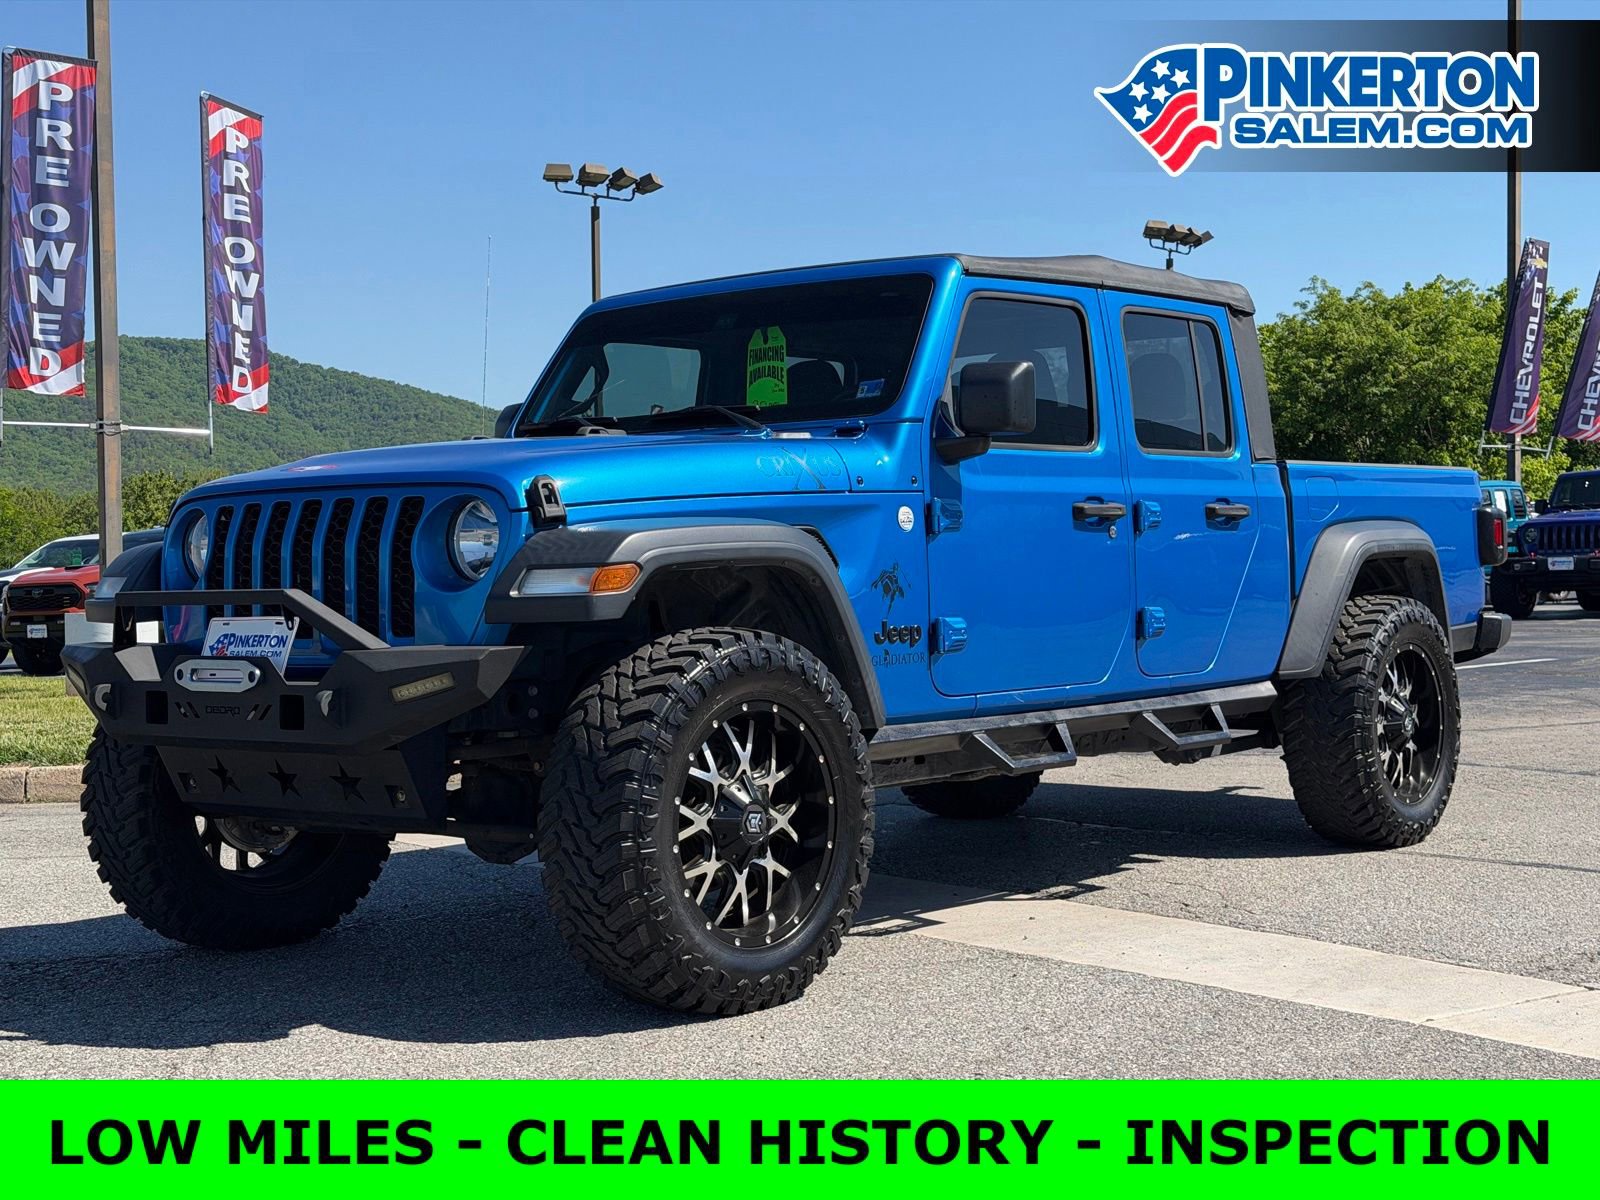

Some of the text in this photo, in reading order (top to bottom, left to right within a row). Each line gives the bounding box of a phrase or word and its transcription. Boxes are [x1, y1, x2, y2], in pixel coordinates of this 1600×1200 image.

[23, 80, 77, 377] PRE OWNED
[223, 126, 260, 394] PRE OWNED
[749, 344, 785, 368] FINANCING
[1509, 276, 1544, 425] CHEVROLET
[749, 364, 785, 388] AVAILABLE
[226, 632, 289, 652] PINKERTON
[874, 619, 922, 648] Jeep
